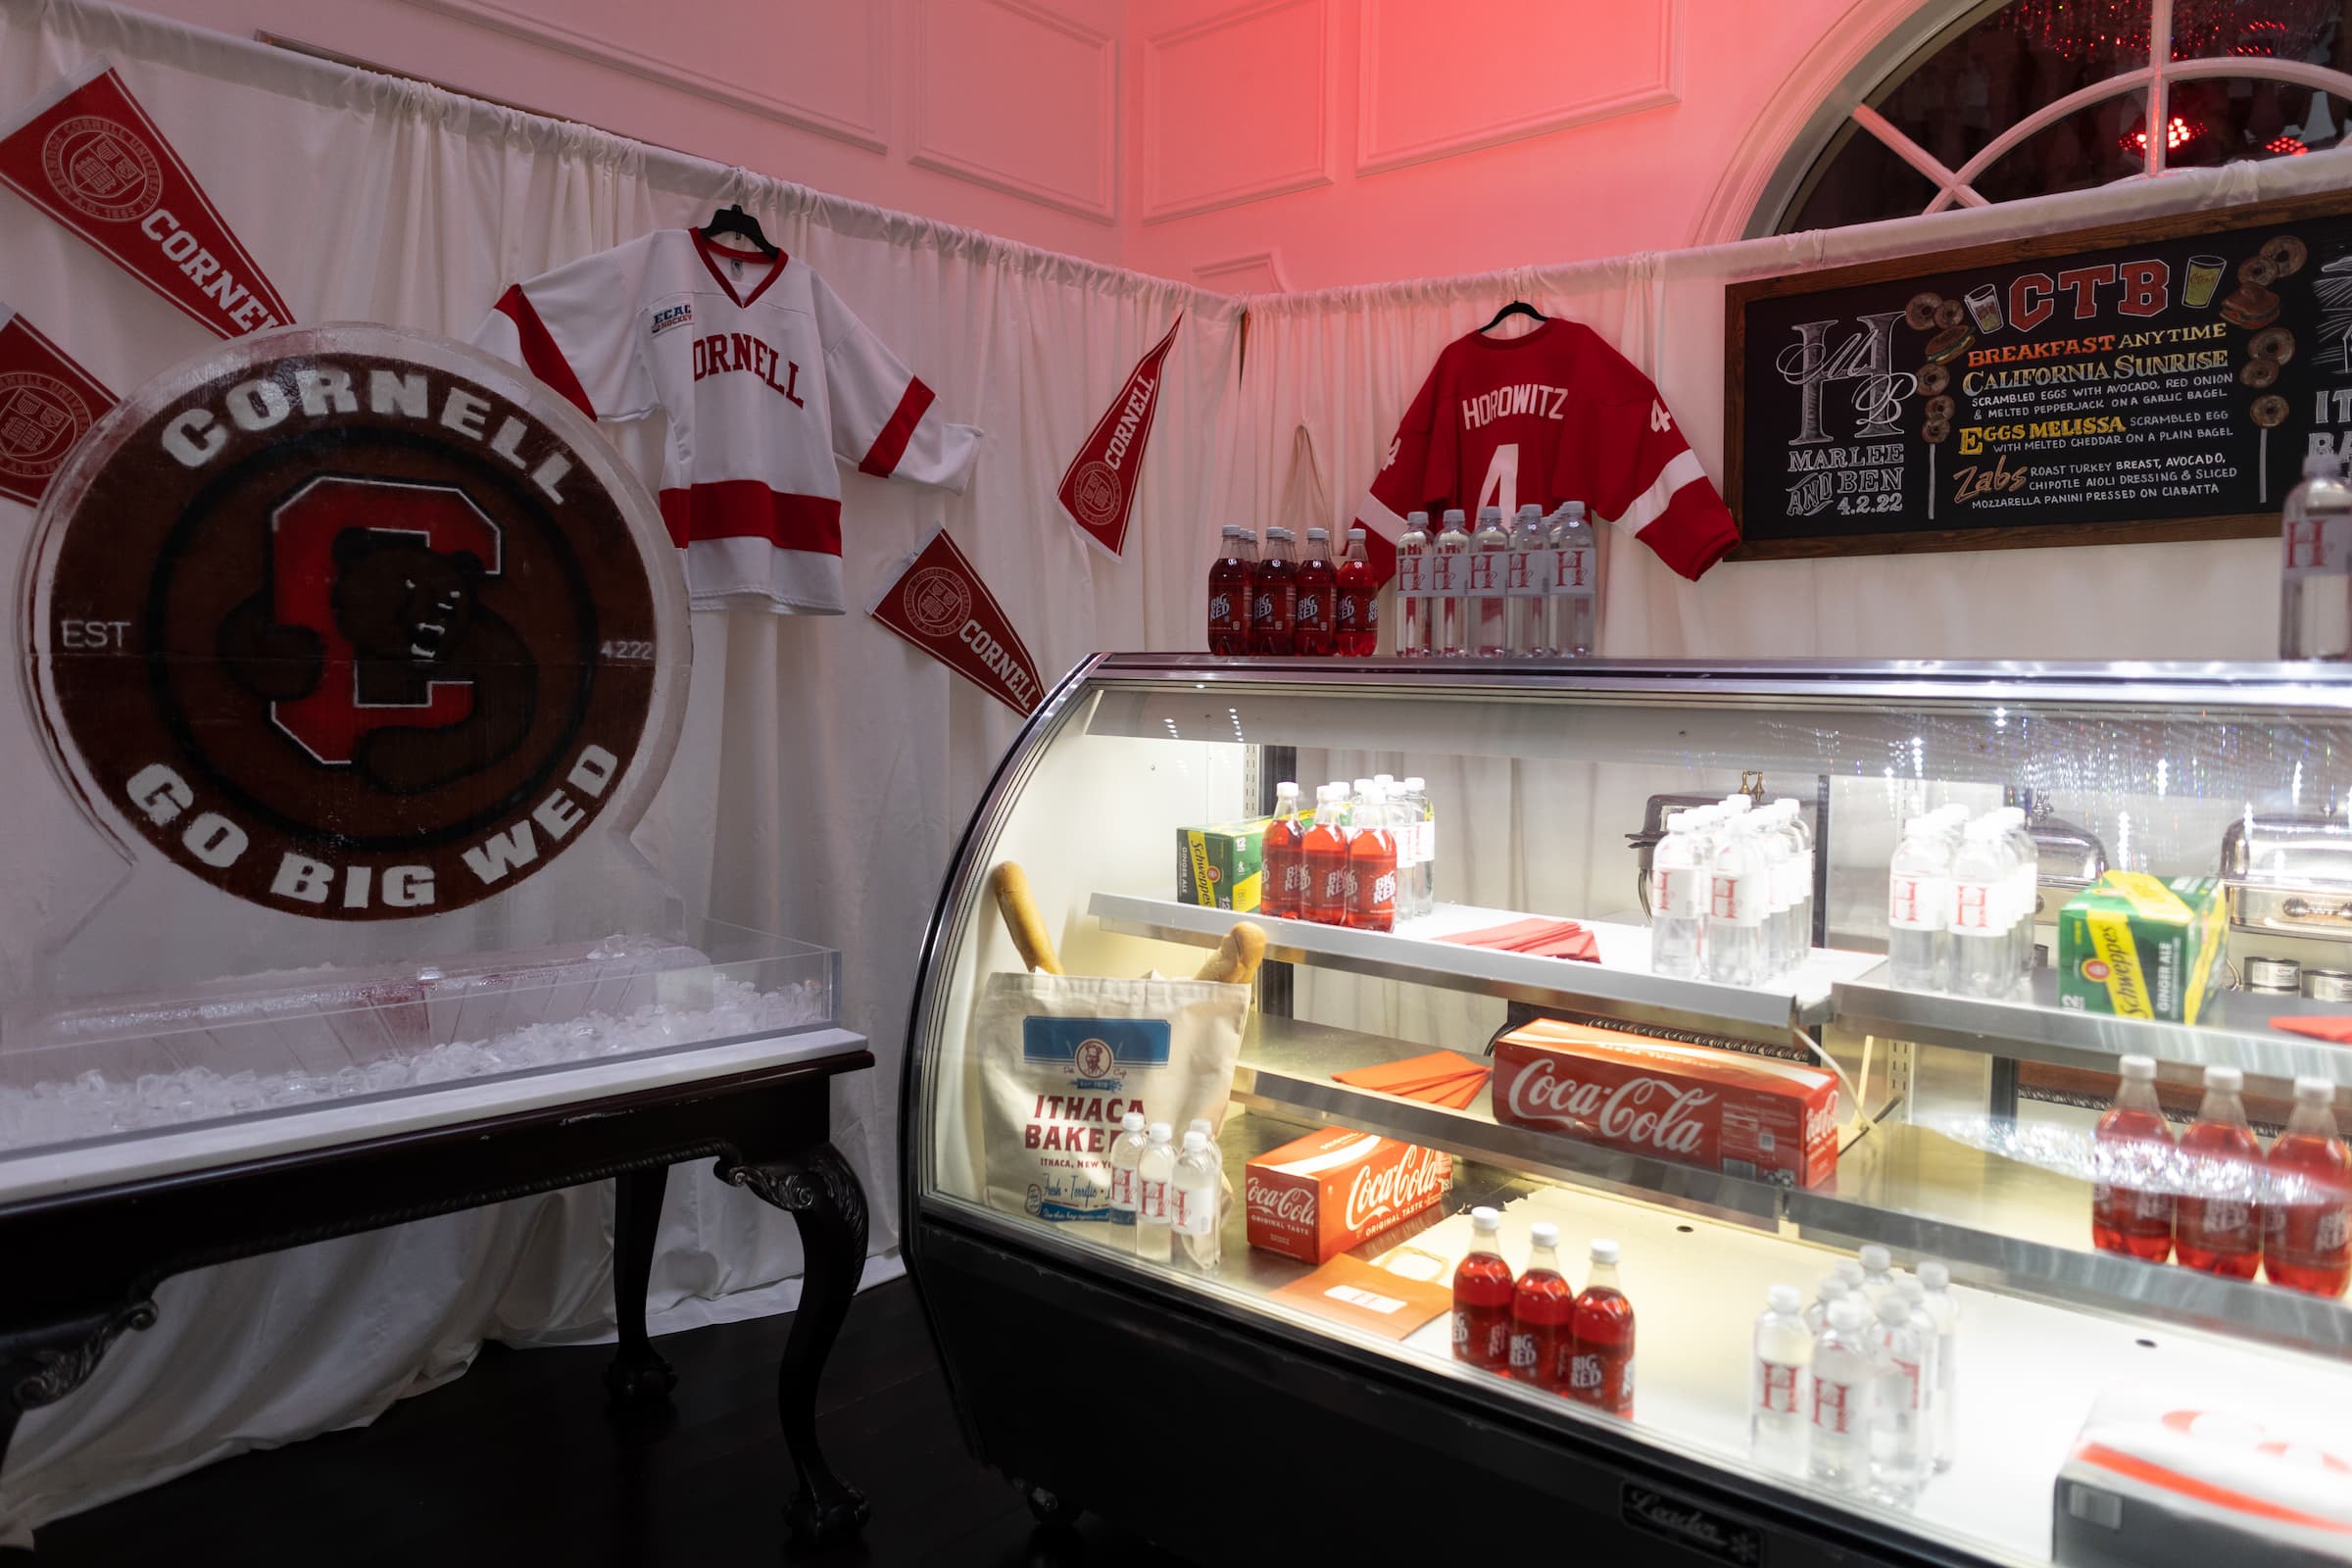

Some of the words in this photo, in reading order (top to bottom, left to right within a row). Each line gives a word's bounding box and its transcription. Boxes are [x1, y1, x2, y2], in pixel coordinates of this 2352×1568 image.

[2009, 259, 2170, 332] CTB
[654, 305, 691, 324] ECAC
[662, 315, 692, 329] HOCKEY
[1967, 335, 2116, 368] BREAKFAST
[2118, 322, 2228, 350] ANYTIME
[693, 332, 804, 410] ORNELL
[1962, 361, 2110, 397] CALIFORNIA
[2113, 349, 2230, 380] SUNRISE
[1972, 391, 2035, 408] SCRAMBLED
[2040, 388, 2067, 400] EGGS
[2073, 385, 2102, 398] WITH
[2165, 376, 2188, 389] RED
[2193, 372, 2233, 386] ONION
[1973, 409, 1983, 420] &
[1987, 405, 2030, 419] MELTED
[2034, 399, 2105, 416] PEPPERJACK
[2111, 396, 2129, 408] ON
[2130, 395, 2138, 407] A
[2142, 392, 2182, 406] GARLIC
[2186, 388, 2228, 401] BAGEL
[1462, 383, 1568, 431] HOROWITZ
[161, 369, 577, 505] CORNELL
[1105, 374, 1154, 471] CORNELL
[1959, 422, 2025, 455] EGGS
[2029, 416, 2127, 440] MELISSA
[2130, 412, 2201, 427] SCRAMBLED
[2206, 410, 2229, 421] EGG
[1993, 442, 2022, 454] WITH
[2025, 439, 2067, 453] MELTED
[2071, 434, 2123, 449] CHEDDAR
[2126, 433, 2144, 444] ON
[2147, 431, 2156, 442] A
[2160, 428, 2193, 441] PLAIN
[2197, 425, 2233, 438] BAGEL
[1788, 443, 1904, 472] MARLEE
[1837, 466, 1904, 494] BEN
[1952, 454, 2029, 505] Zabs
[2031, 465, 2067, 477] ROAST
[2069, 462, 2112, 475] TURKEY
[2116, 458, 2162, 471] BREAST,
[2165, 452, 2227, 468] AVOCADO,
[2029, 478, 2081, 491] CHIPOTLE
[2086, 475, 2115, 488] AIOLI
[2120, 470, 2179, 485] DRESSING
[2181, 469, 2191, 481] &
[2195, 466, 2238, 480] SLICED
[1787, 472, 1834, 516] AND
[1837, 492, 1903, 515] 4.2.22
[1972, 495, 2041, 510] MOZZARELLA
[2044, 491, 2083, 505] PANINI
[2085, 488, 2136, 503] PRESSED
[2139, 486, 2157, 498] ON
[2162, 483, 2221, 497] CIABATTA
[1297, 604, 1318, 622] RED
[1298, 595, 1315, 611] BIG
[61, 619, 131, 649] EST
[959, 619, 1038, 710] CORNELL
[125, 762, 250, 869] GO
[270, 853, 435, 908] BIG
[461, 743, 619, 886] WED
[2159, 941, 2172, 962] ALE
[2102, 925, 2149, 1018] Schweppes
[2157, 966, 2171, 1011] GINGER
[1034, 1094, 1146, 1124] ITHACA
[1508, 1058, 1718, 1154] Coca-Cola
[1025, 1124, 1123, 1153] BAKE
[1041, 1157, 1074, 1168] ITHACA,
[1077, 1159, 1099, 1169] NEW
[1346, 1145, 1437, 1232] Coca-Cola
[1250, 1214, 1286, 1231] ORIGINAL
[1287, 1224, 1310, 1237] TASTE
[1365, 1214, 1399, 1237] ORIGINAL
[1401, 1200, 1424, 1217] TASTE
[1511, 1334, 1532, 1350] BIG
[1509, 1348, 1537, 1367] RED
[1572, 1354, 1598, 1372] BIG
[1571, 1369, 1602, 1388] RED
